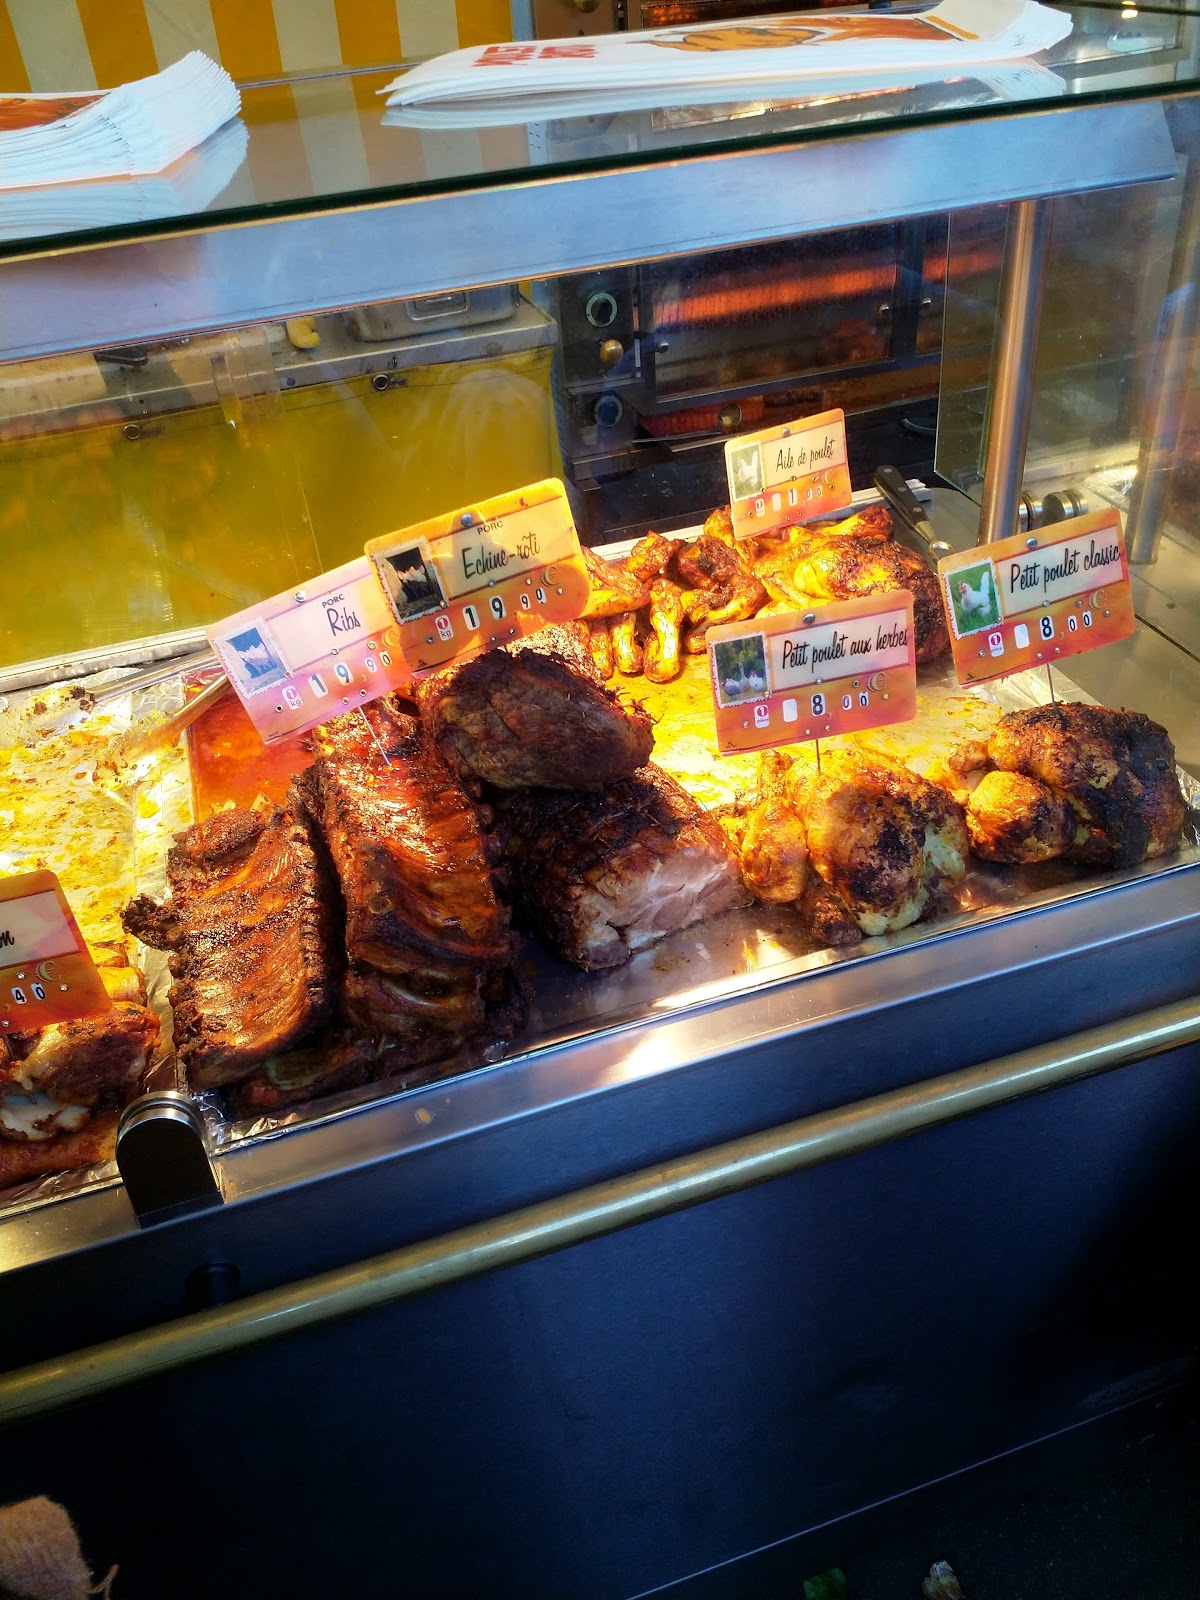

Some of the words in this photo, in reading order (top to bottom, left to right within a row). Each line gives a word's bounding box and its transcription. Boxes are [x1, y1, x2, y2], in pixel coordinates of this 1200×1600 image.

[776, 447, 795, 472] Aile
[797, 447, 807, 466] de
[809, 436, 835, 470] poulet
[477, 520, 504, 536] PORC
[461, 531, 541, 579] Echine-rôti
[1010, 562, 1040, 593] Petit
[1043, 548, 1081, 593] poulet
[1083, 540, 1121, 571] classic
[321, 593, 345, 609] PORC
[326, 607, 361, 637] Ribs
[440, 629, 452, 638] kg
[782, 640, 811, 670] Petit
[811, 631, 849, 674] poulet
[850, 637, 872, 656] aux
[875, 622, 908, 651] herbes
[290, 699, 301, 708] kg
